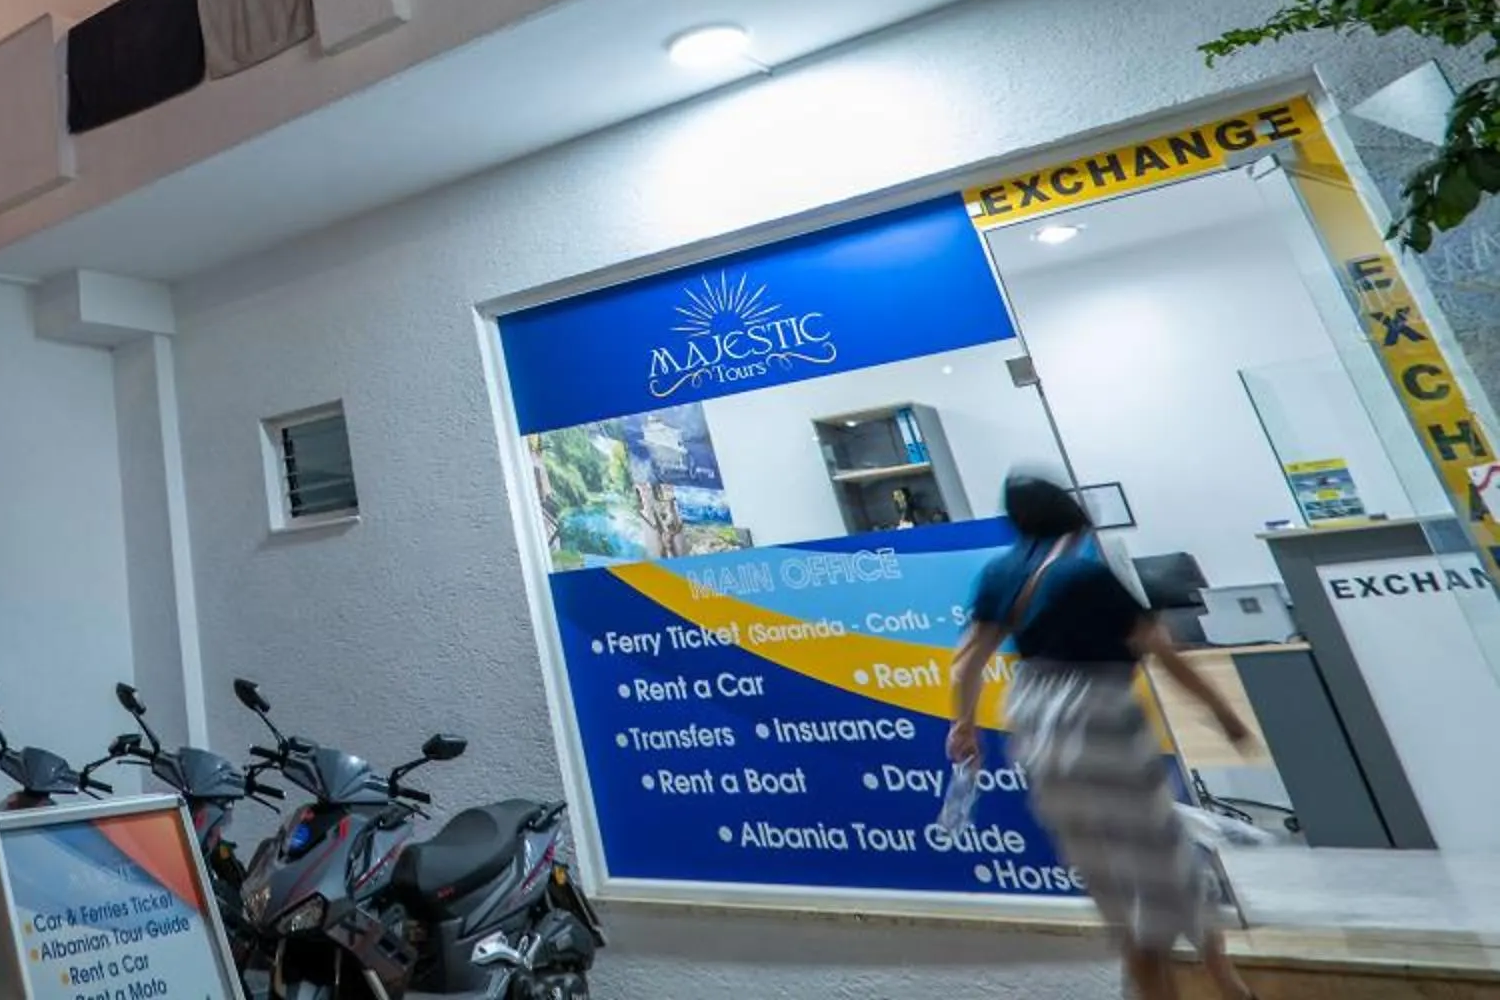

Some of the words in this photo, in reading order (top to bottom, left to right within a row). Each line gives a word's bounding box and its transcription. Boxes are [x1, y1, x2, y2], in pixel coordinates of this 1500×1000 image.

[979, 106, 1304, 216] EXCHANGE
[649, 312, 831, 377] MAJESTIC
[711, 362, 767, 383] Tours
[686, 562, 775, 600] MAIN
[780, 547, 903, 590] OFFICE
[606, 631, 661, 656] Ferry
[666, 621, 741, 649] Ticket
[748, 617, 846, 645] (Saranda
[866, 608, 931, 633] Corfu
[634, 676, 687, 702] Rent
[694, 679, 713, 698] a
[717, 672, 765, 697] Car
[873, 660, 942, 689] Rent
[628, 723, 736, 750] Transfers
[772, 717, 916, 743] Insurance
[658, 769, 714, 794] Rent
[720, 774, 739, 794] a
[744, 767, 808, 794] Boat
[882, 765, 943, 797] Day
[740, 822, 848, 850] Albania
[851, 823, 917, 851] Tour
[924, 823, 1026, 854] Guide
[993, 859, 1088, 891] Horse
[33, 913, 63, 933] Car
[66, 908, 77, 926] &
[80, 901, 129, 924] Ferries
[130, 892, 174, 913] Ticket
[41, 934, 109, 962] Albanian
[112, 926, 144, 944] Tour
[145, 915, 191, 939] Guide
[69, 960, 104, 985] Rent
[107, 962, 119, 977] a
[121, 954, 149, 973] Car
[128, 977, 168, 1000] Moto
